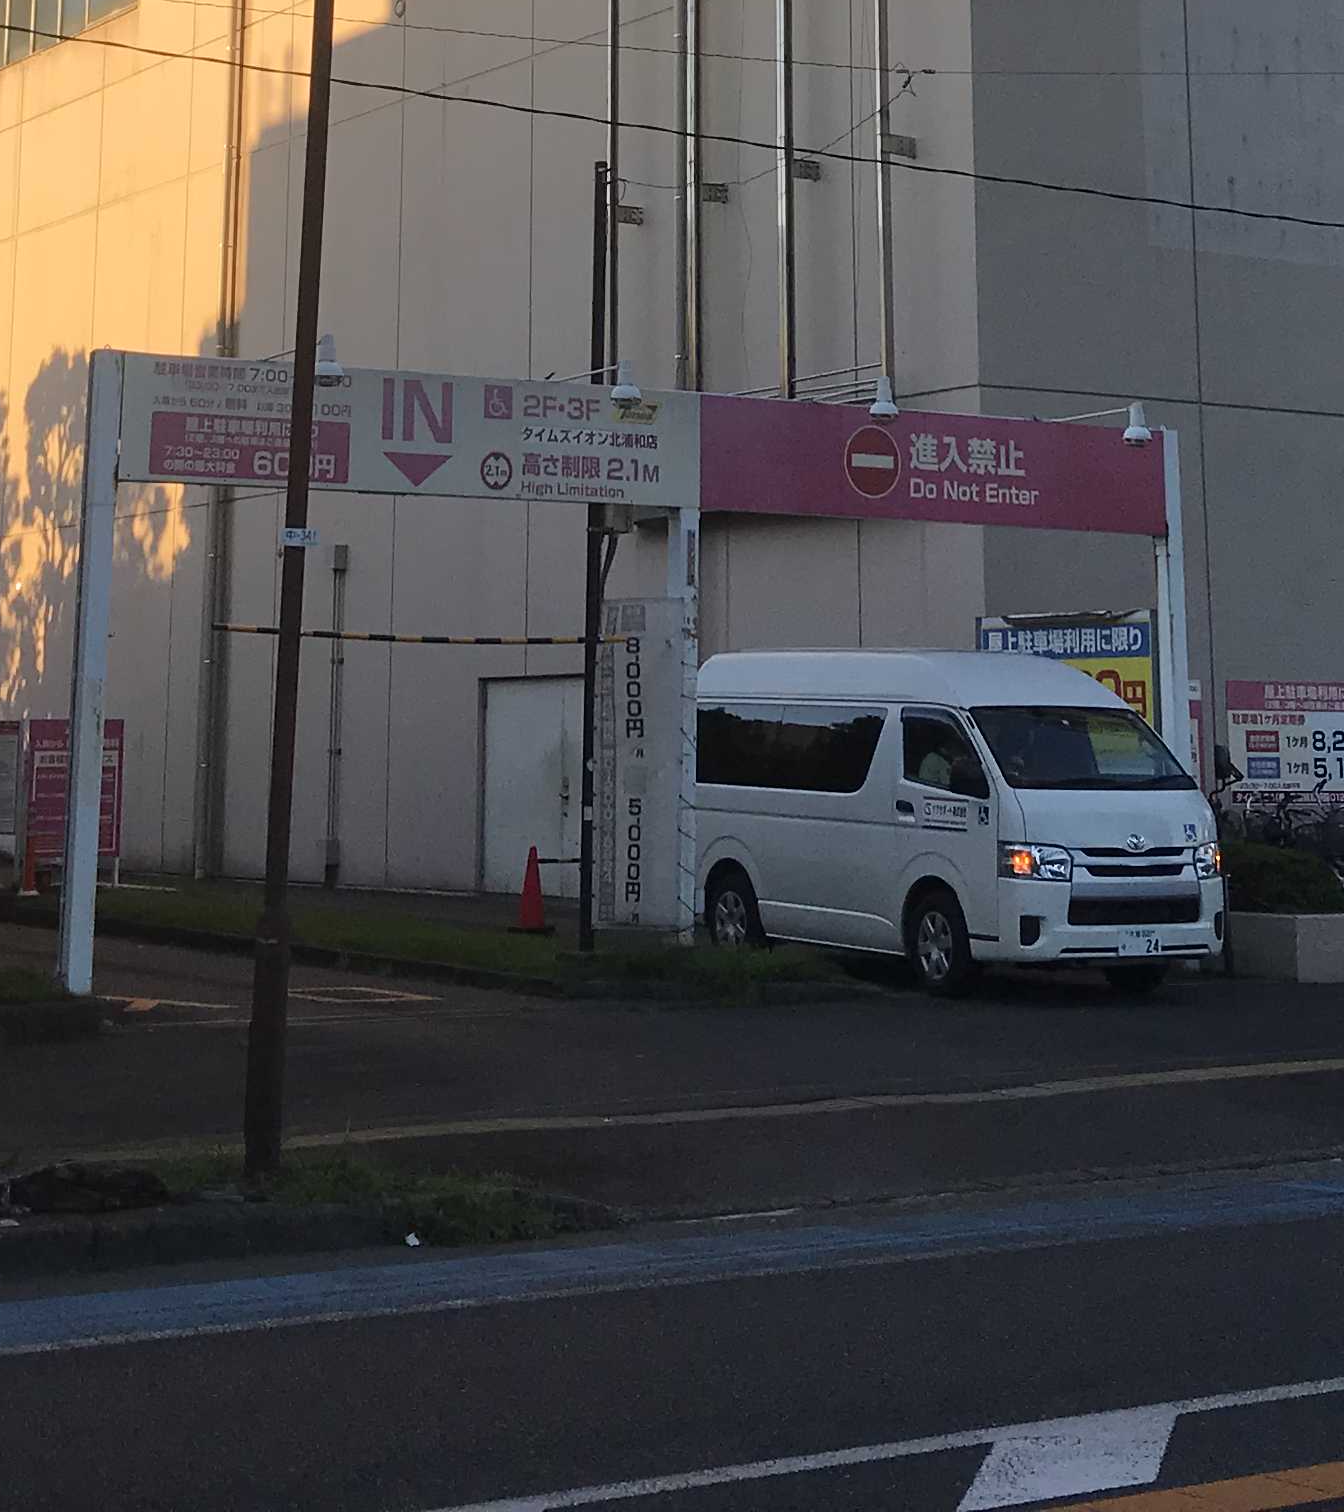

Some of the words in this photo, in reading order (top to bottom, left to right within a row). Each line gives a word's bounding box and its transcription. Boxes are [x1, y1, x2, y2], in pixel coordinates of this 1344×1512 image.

[381, 377, 454, 444] IN
[521, 451, 601, 479] 高さ制限
[909, 432, 1026, 478] 進入禁止
[520, 480, 554, 498] High
[557, 482, 625, 500] Limitation
[909, 477, 937, 500] Do
[943, 481, 979, 503] Not
[985, 483, 1040, 506] Enter
